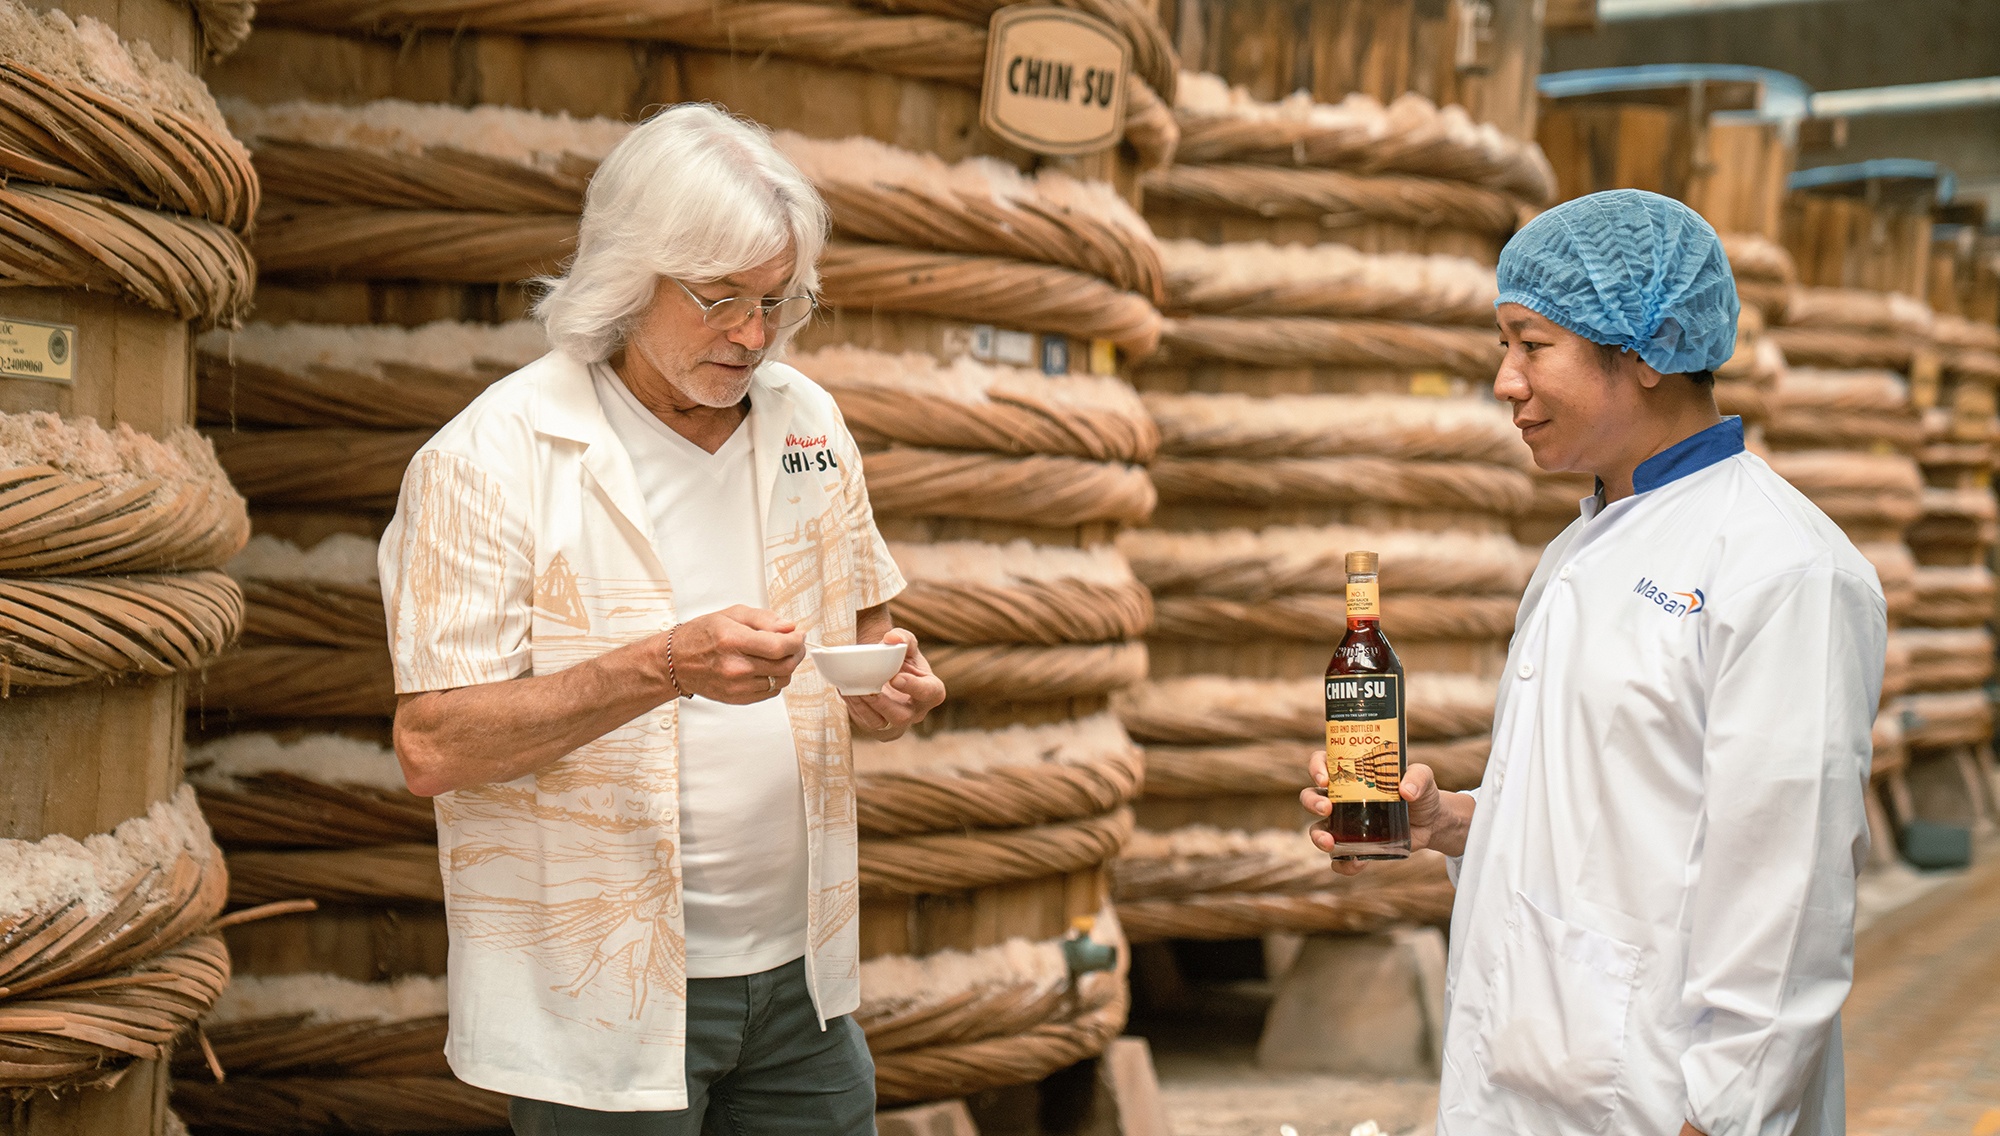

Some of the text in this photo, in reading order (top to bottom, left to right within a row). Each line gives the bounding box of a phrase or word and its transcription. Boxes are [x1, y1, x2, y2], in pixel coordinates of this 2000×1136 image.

[1007, 56, 1115, 109] CHIN-SU
[1632, 577, 1687, 618] Masan
[1326, 681, 1386, 700] CHIN-SU
[1350, 724, 1374, 733] BOTTLED
